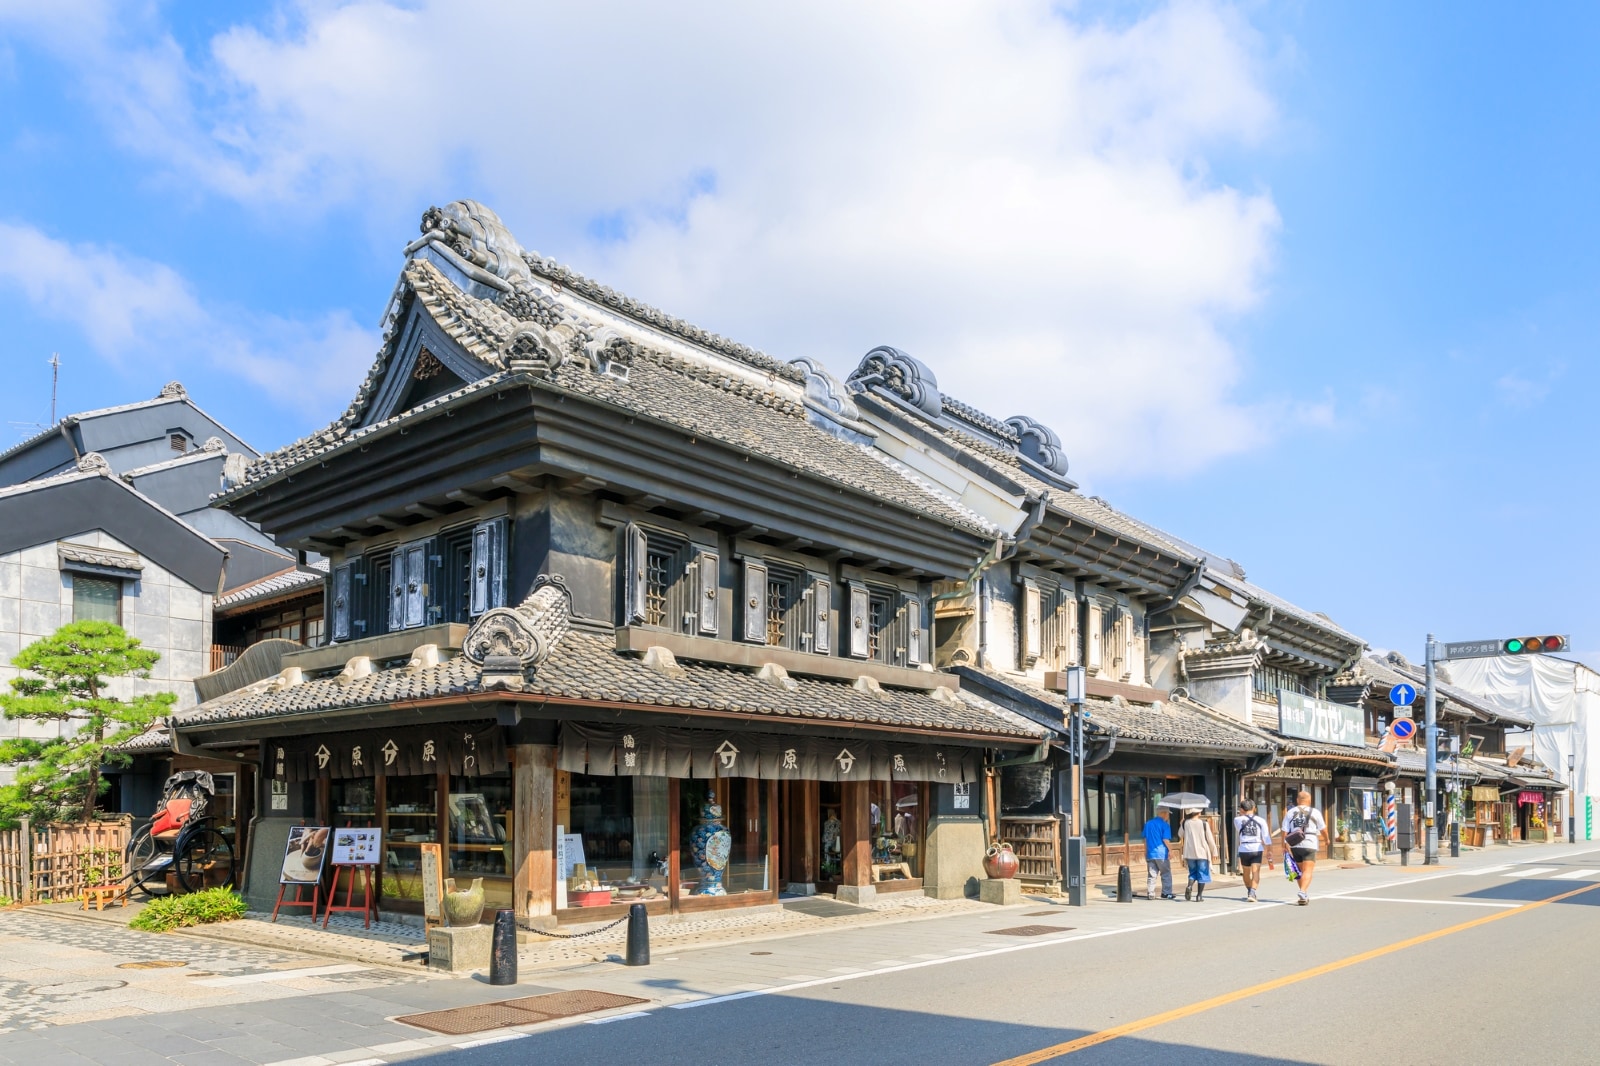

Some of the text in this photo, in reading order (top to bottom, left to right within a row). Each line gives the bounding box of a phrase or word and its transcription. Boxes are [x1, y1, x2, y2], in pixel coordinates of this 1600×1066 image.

[1449, 643, 1496, 655] 押ボタン信号
[352, 746, 363, 766] 原
[422, 740, 437, 762] 原
[782, 748, 798, 770] 原
[894, 754, 907, 773] 原
